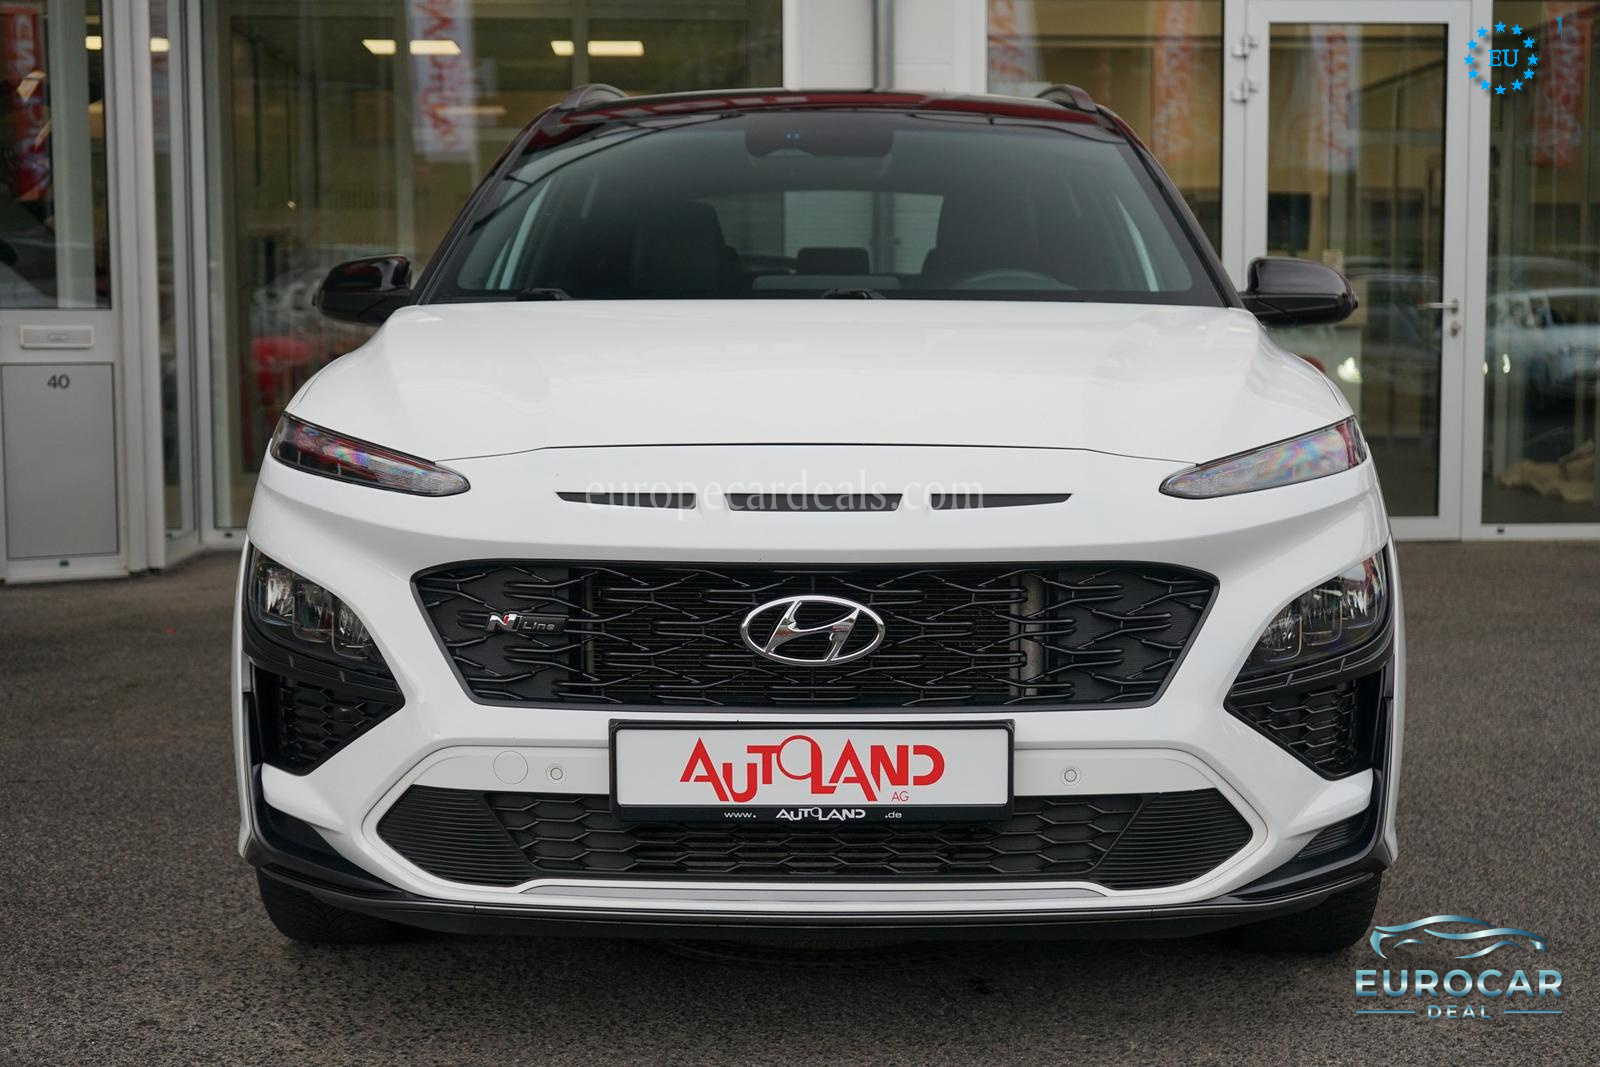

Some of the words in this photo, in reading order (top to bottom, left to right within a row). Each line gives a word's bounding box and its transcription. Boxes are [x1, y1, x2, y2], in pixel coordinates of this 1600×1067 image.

[47, 373, 71, 389] 40
[522, 621, 556, 631] Line
[891, 790, 909, 802] AG
[884, 810, 902, 819] .de
